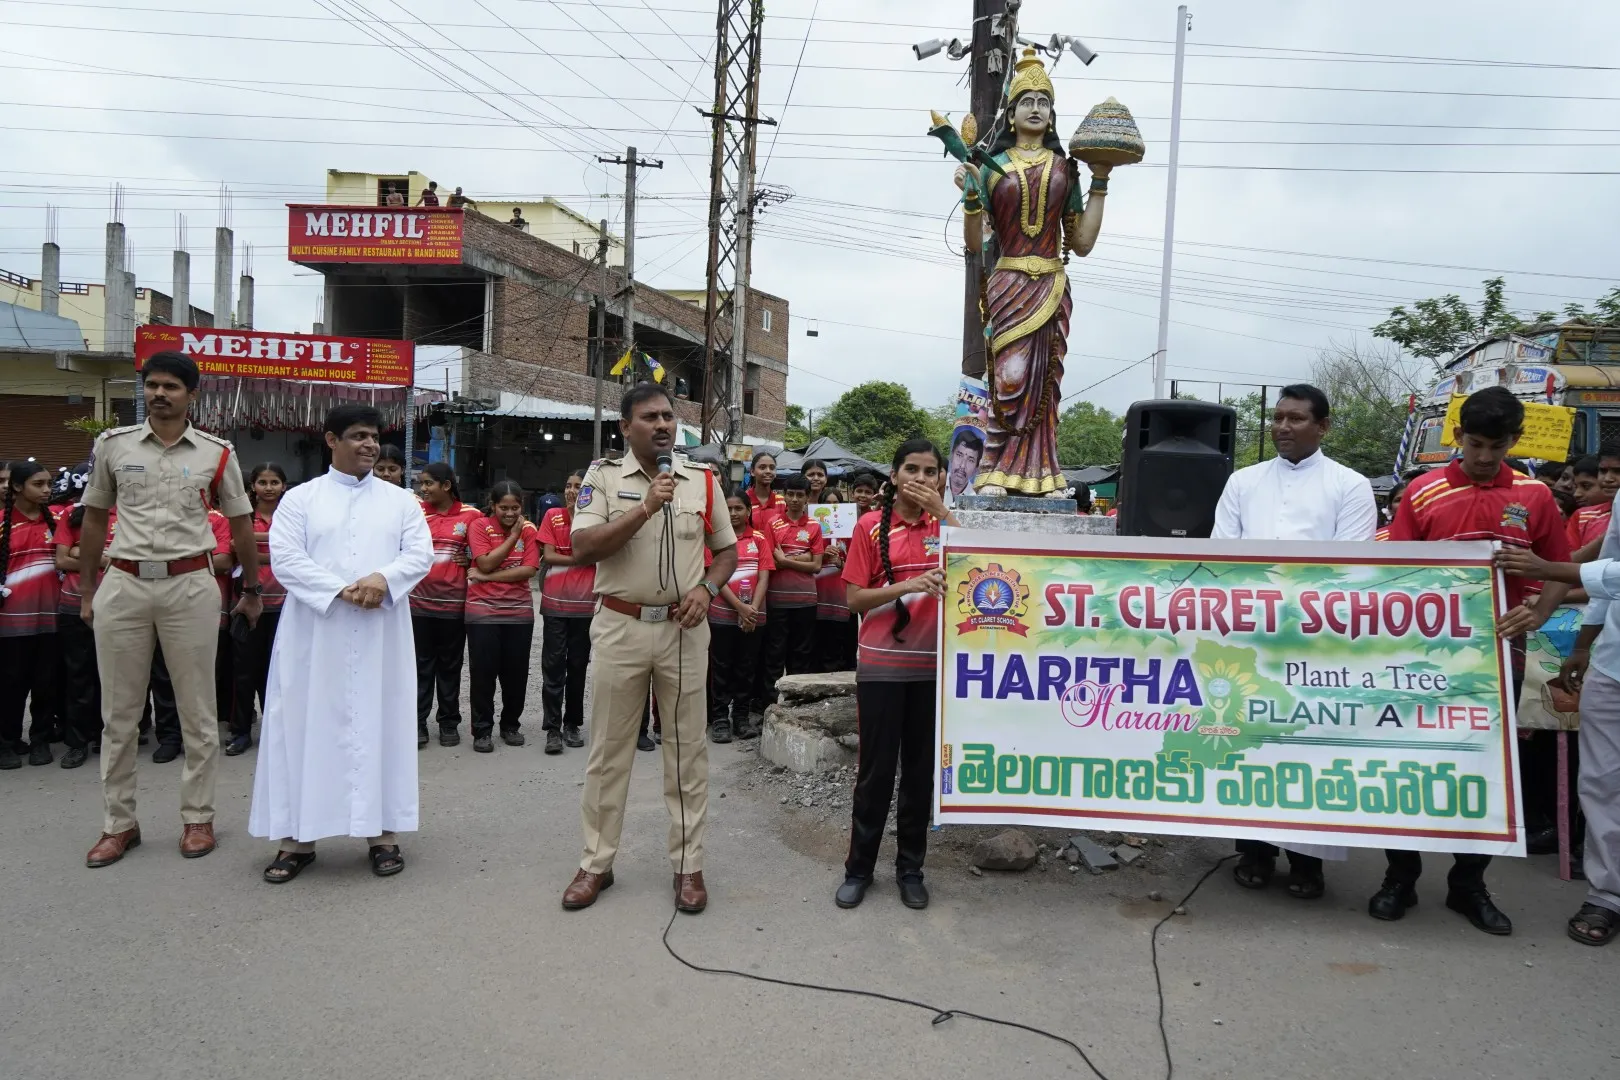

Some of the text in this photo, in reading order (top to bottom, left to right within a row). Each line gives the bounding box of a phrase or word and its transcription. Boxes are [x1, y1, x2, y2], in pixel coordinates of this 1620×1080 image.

[305, 212, 424, 239] MEHFIL
[291, 245, 459, 258] MULTI CUISINE FAMILY RESTAURANT & MANDI HOUSE
[142, 332, 177, 341] The New
[180, 332, 354, 364] MEHFIL
[205, 361, 235, 372] FAMILY
[237, 364, 291, 376] RESTAURANT
[293, 367, 299, 376] &
[301, 368, 327, 377] MANDI
[329, 369, 357, 380] HOUSE
[996, 617, 1015, 626] SCHOOL
[1044, 583, 1472, 640] ST. CLARET SCHOOL
[955, 652, 1204, 706] HARITHA
[1284, 661, 1448, 691] Plant a Tree
[1060, 679, 1198, 731] Haram
[1248, 699, 1491, 731] PLANT A LIFE
[957, 743, 1205, 804] తెలంగాణకు
